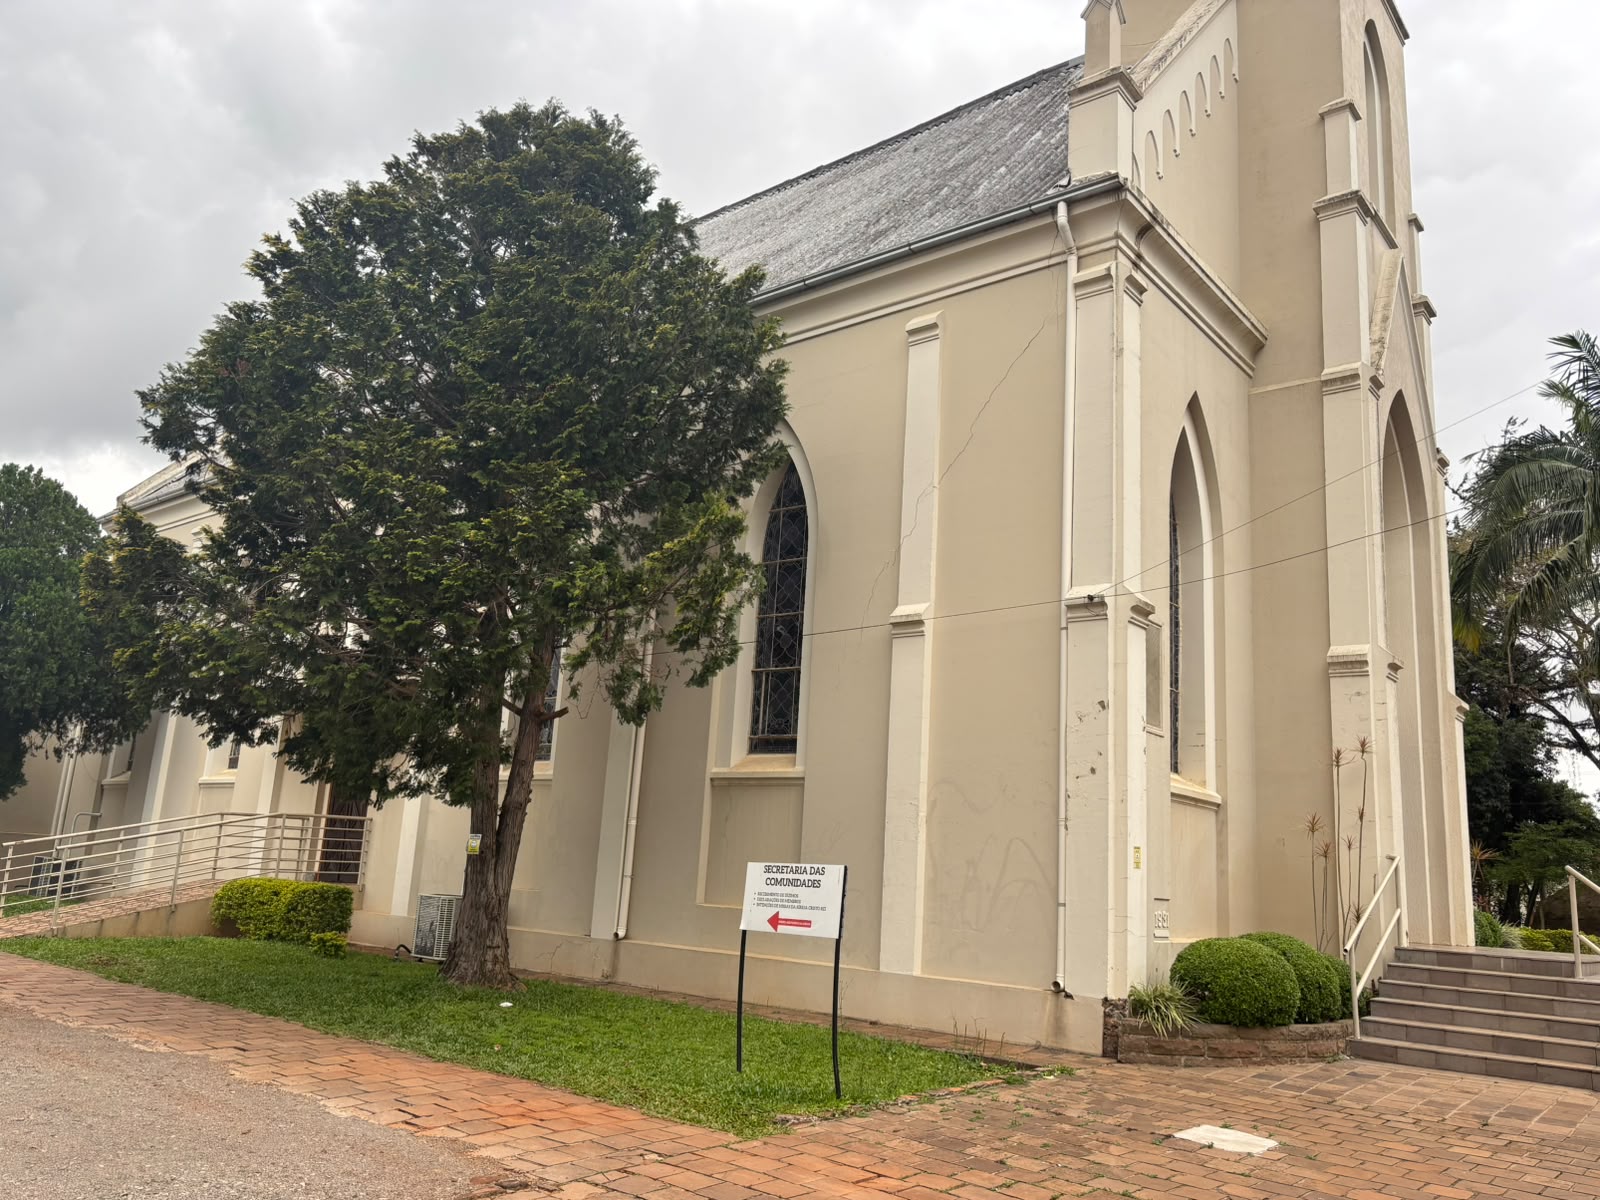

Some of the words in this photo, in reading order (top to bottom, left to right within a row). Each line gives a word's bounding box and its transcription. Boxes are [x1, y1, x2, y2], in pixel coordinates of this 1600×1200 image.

[763, 865, 808, 875] SECRETARIA
[809, 866, 826, 876] DAS
[765, 877, 822, 888] COMUNIDADES
